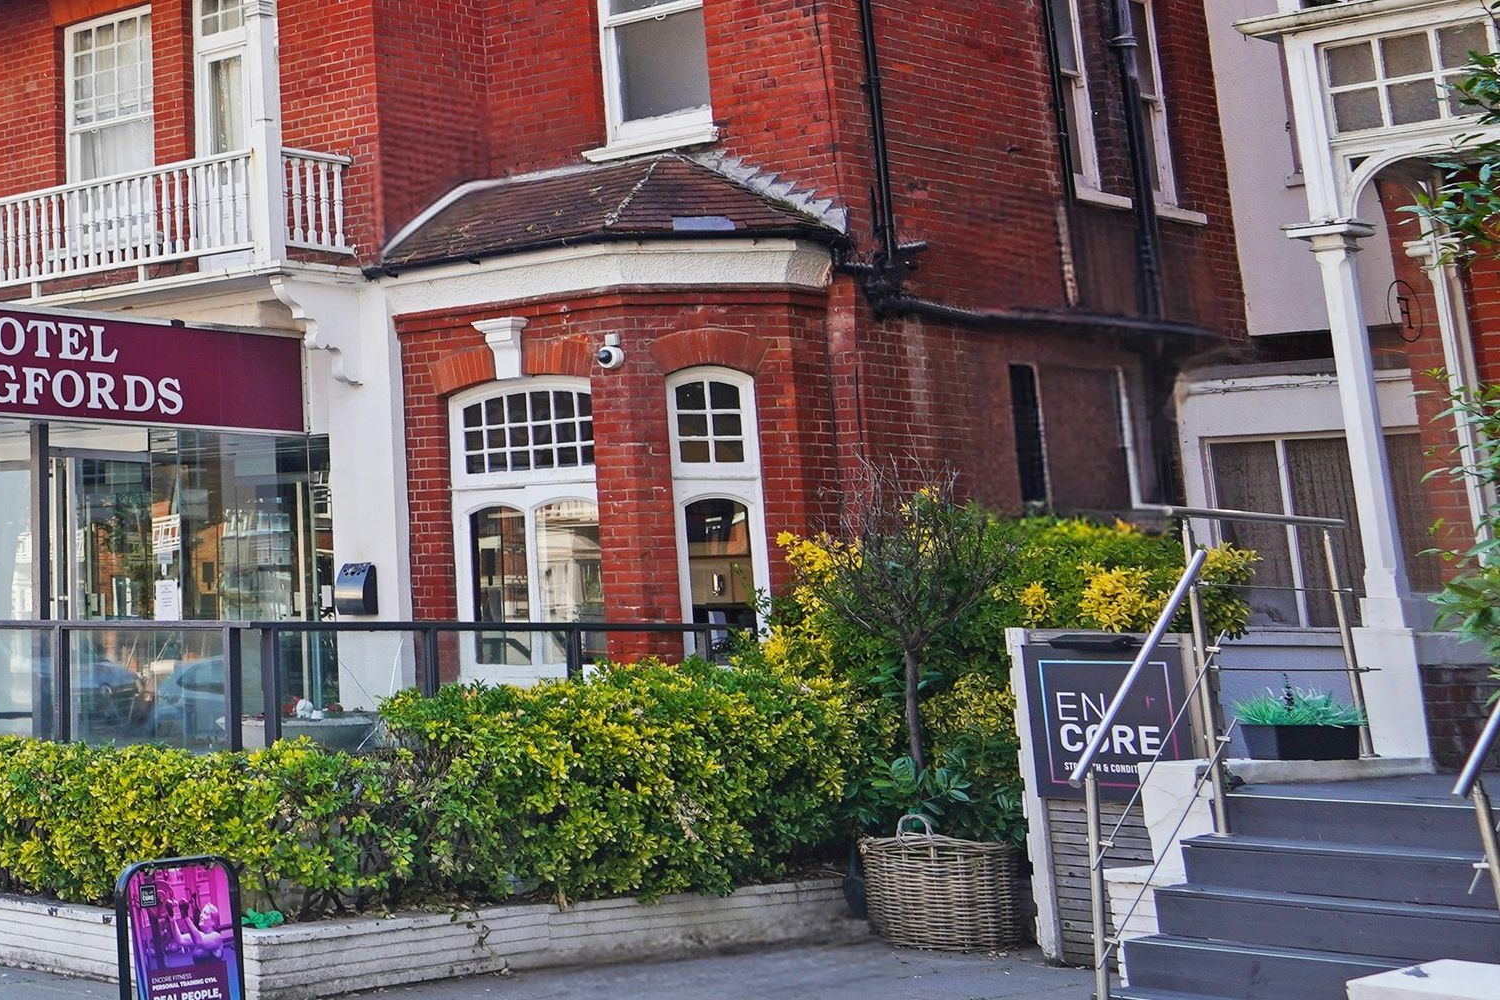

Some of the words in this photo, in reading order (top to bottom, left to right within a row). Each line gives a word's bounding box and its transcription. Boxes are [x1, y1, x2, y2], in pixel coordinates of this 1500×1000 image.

[1056, 691, 1106, 721] EN
[1103, 764, 1109, 772] &
[1110, 763, 1139, 774] CONDIT
[151, 975, 172, 984] ENCORE
[173, 972, 193, 981] FITNESS
[152, 981, 180, 991] PERSONAL
[180, 978, 204, 987] TRAINING
